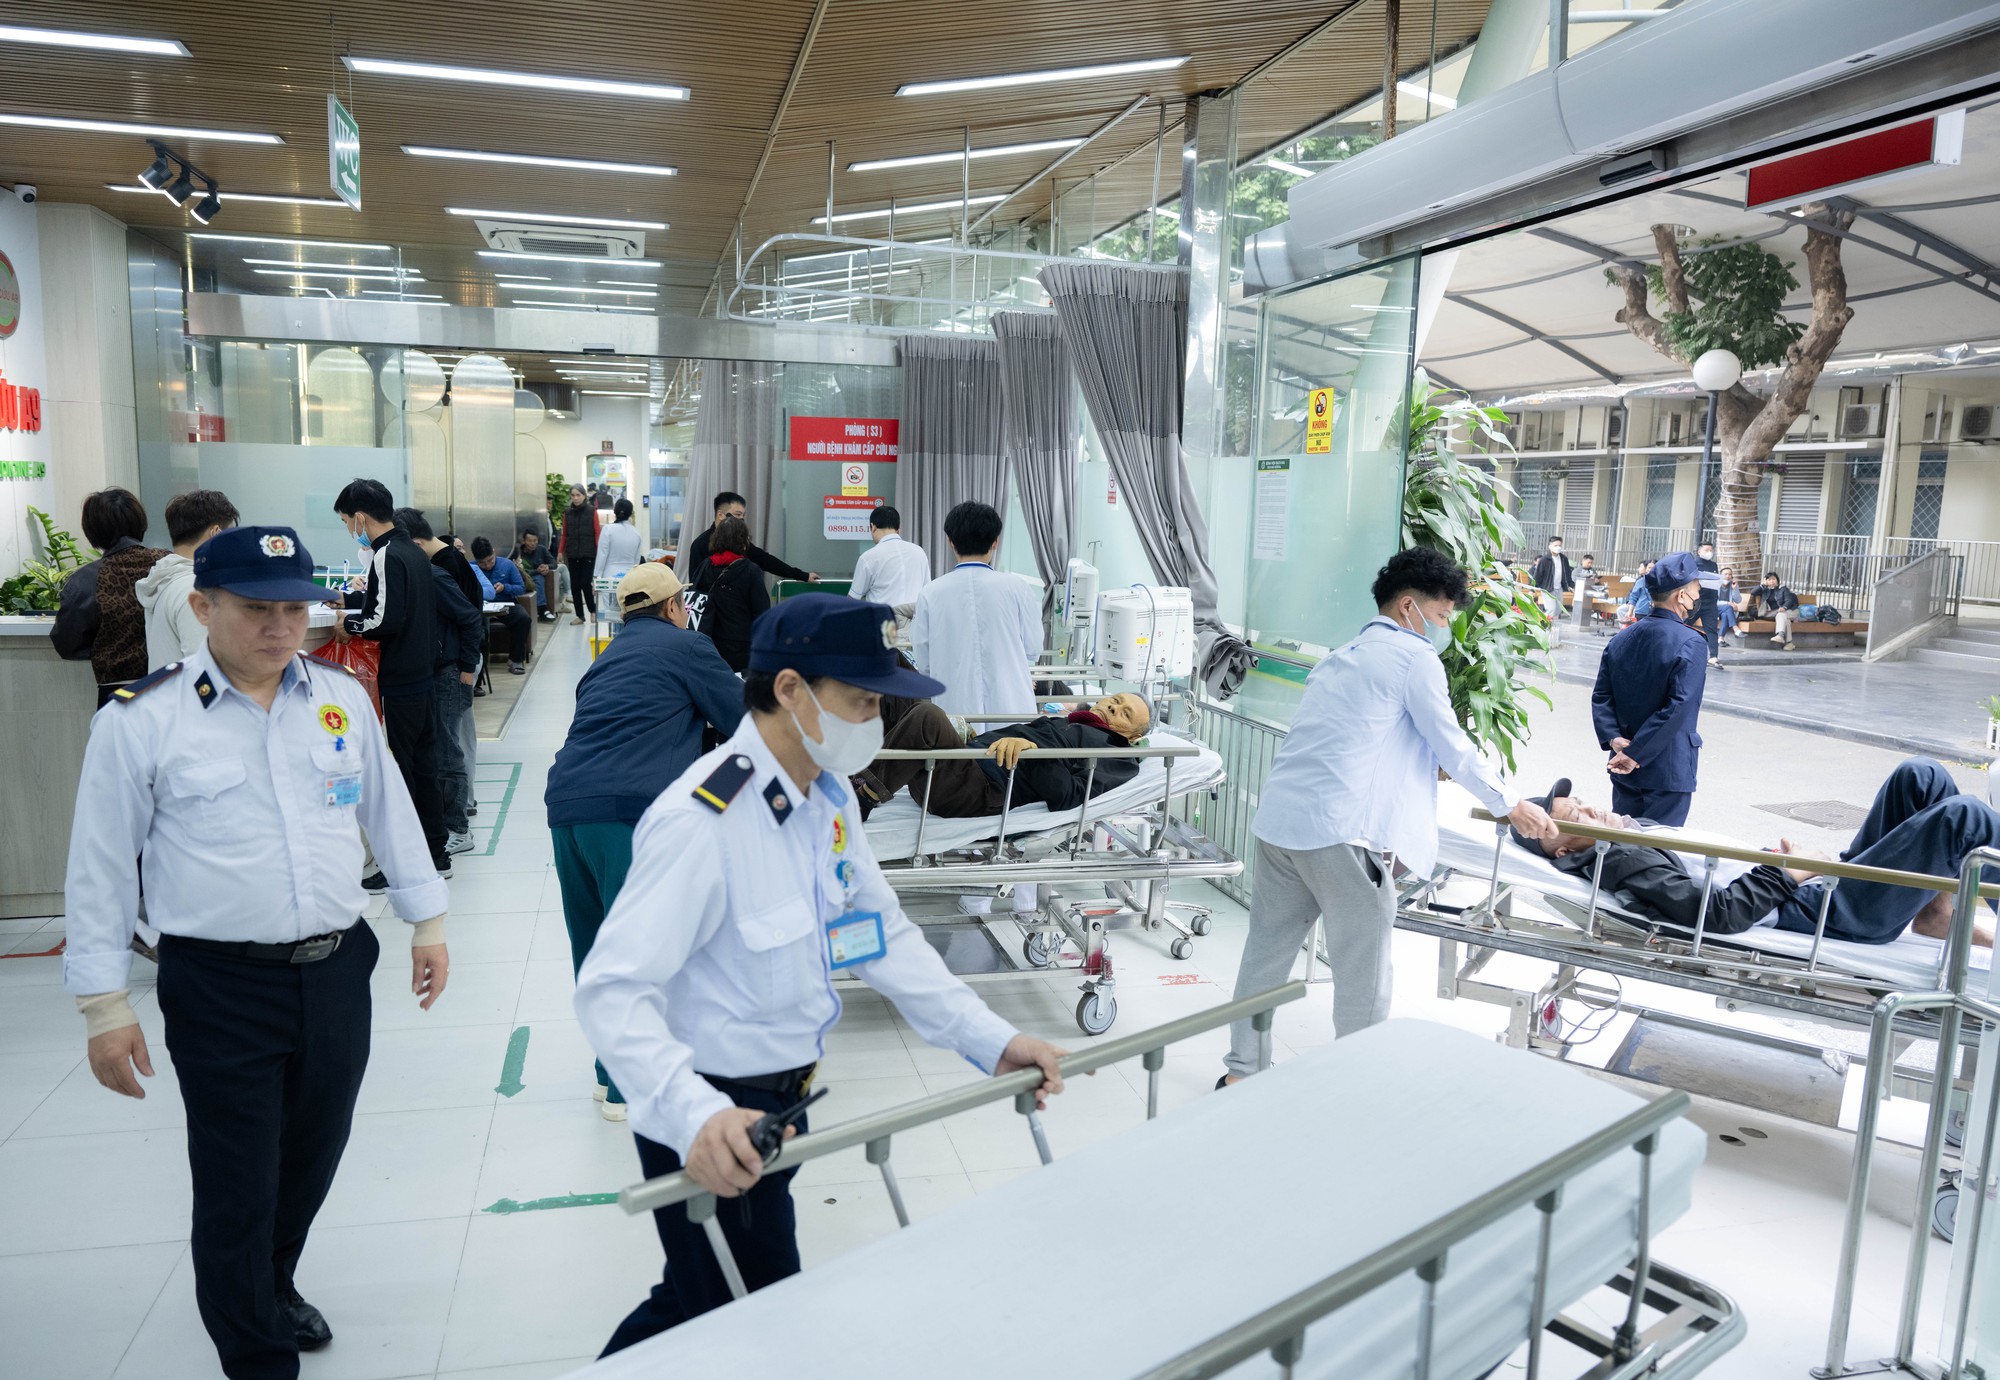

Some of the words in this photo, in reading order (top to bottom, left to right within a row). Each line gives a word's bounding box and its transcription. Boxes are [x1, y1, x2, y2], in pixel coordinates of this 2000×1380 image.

[336, 113, 358, 176] WC
[20, 386, 41, 432] A9
[870, 426, 878, 437] S3
[826, 441, 843, 457] BỆNH
[862, 440, 875, 456] CẤP
[33, 461, 46, 478] A9
